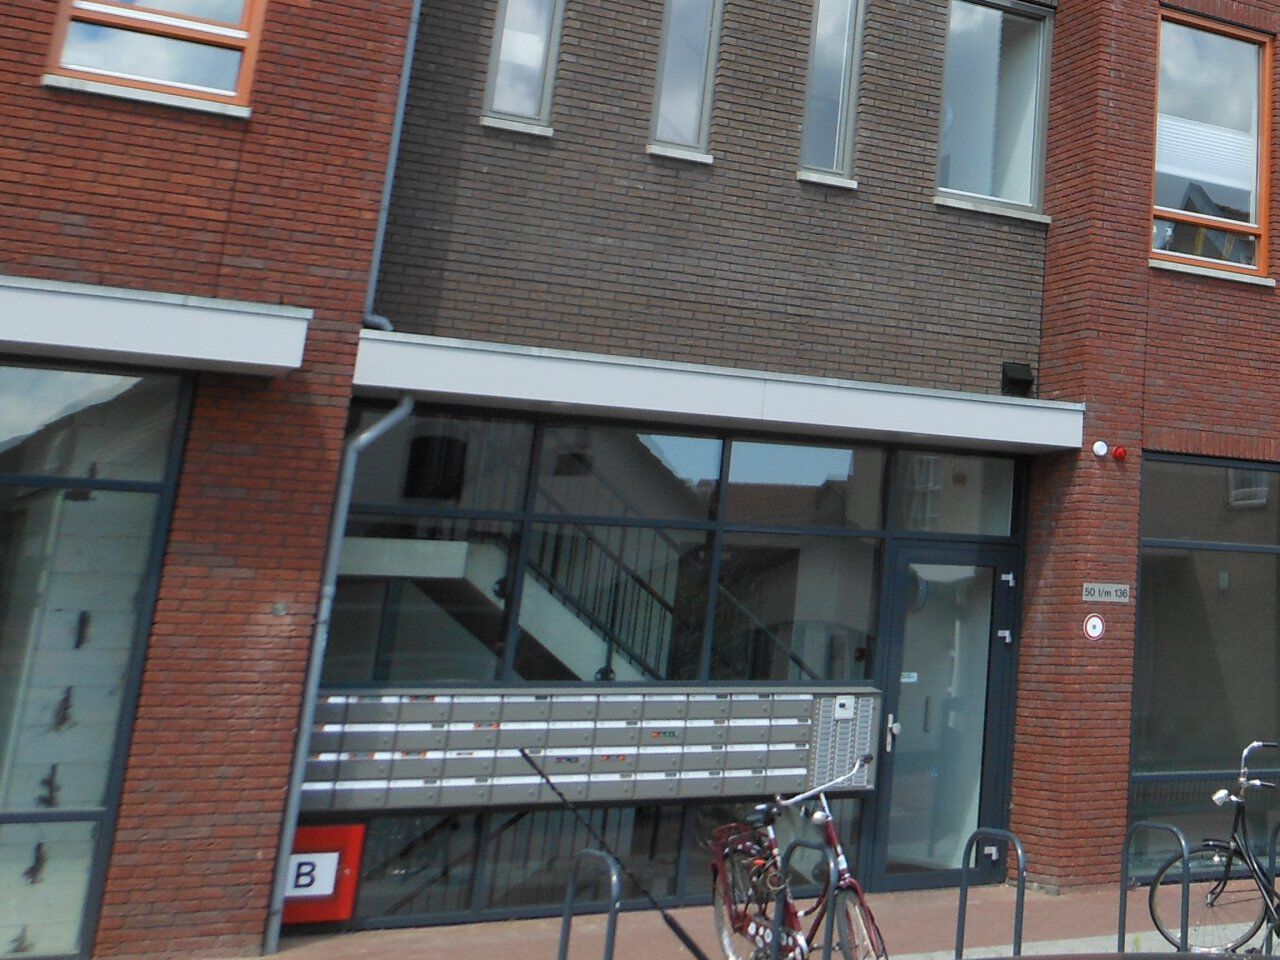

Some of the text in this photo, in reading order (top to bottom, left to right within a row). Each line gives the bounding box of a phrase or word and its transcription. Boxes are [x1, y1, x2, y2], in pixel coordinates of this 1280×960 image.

[1084, 587, 1128, 599] 50 t/m 136
[294, 861, 316, 889] B
